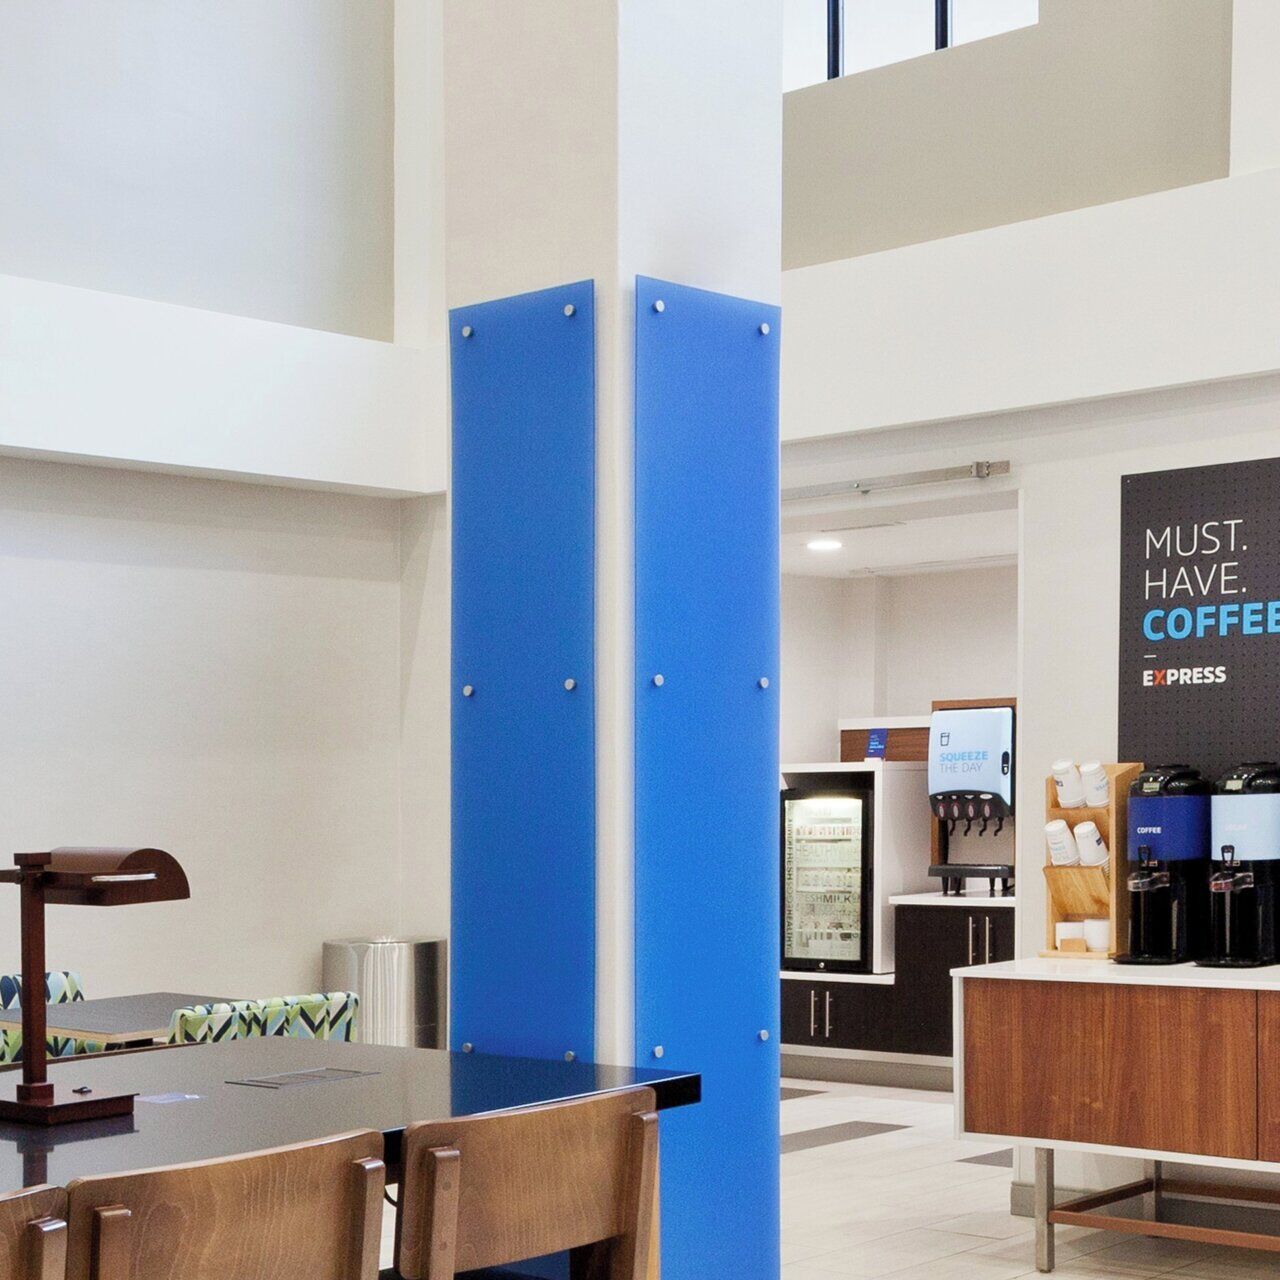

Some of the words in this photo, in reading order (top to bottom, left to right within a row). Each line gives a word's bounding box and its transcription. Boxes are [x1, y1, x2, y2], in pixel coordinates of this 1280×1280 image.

[1145, 519, 1248, 559] MUST.
[1145, 562, 1247, 600] HAVE.
[1142, 666, 1227, 686] EXPRESS
[940, 751, 989, 762] SQUEEZE
[940, 763, 960, 773] THE
[962, 762, 984, 773] DAY
[1137, 826, 1162, 834] COFFEE
